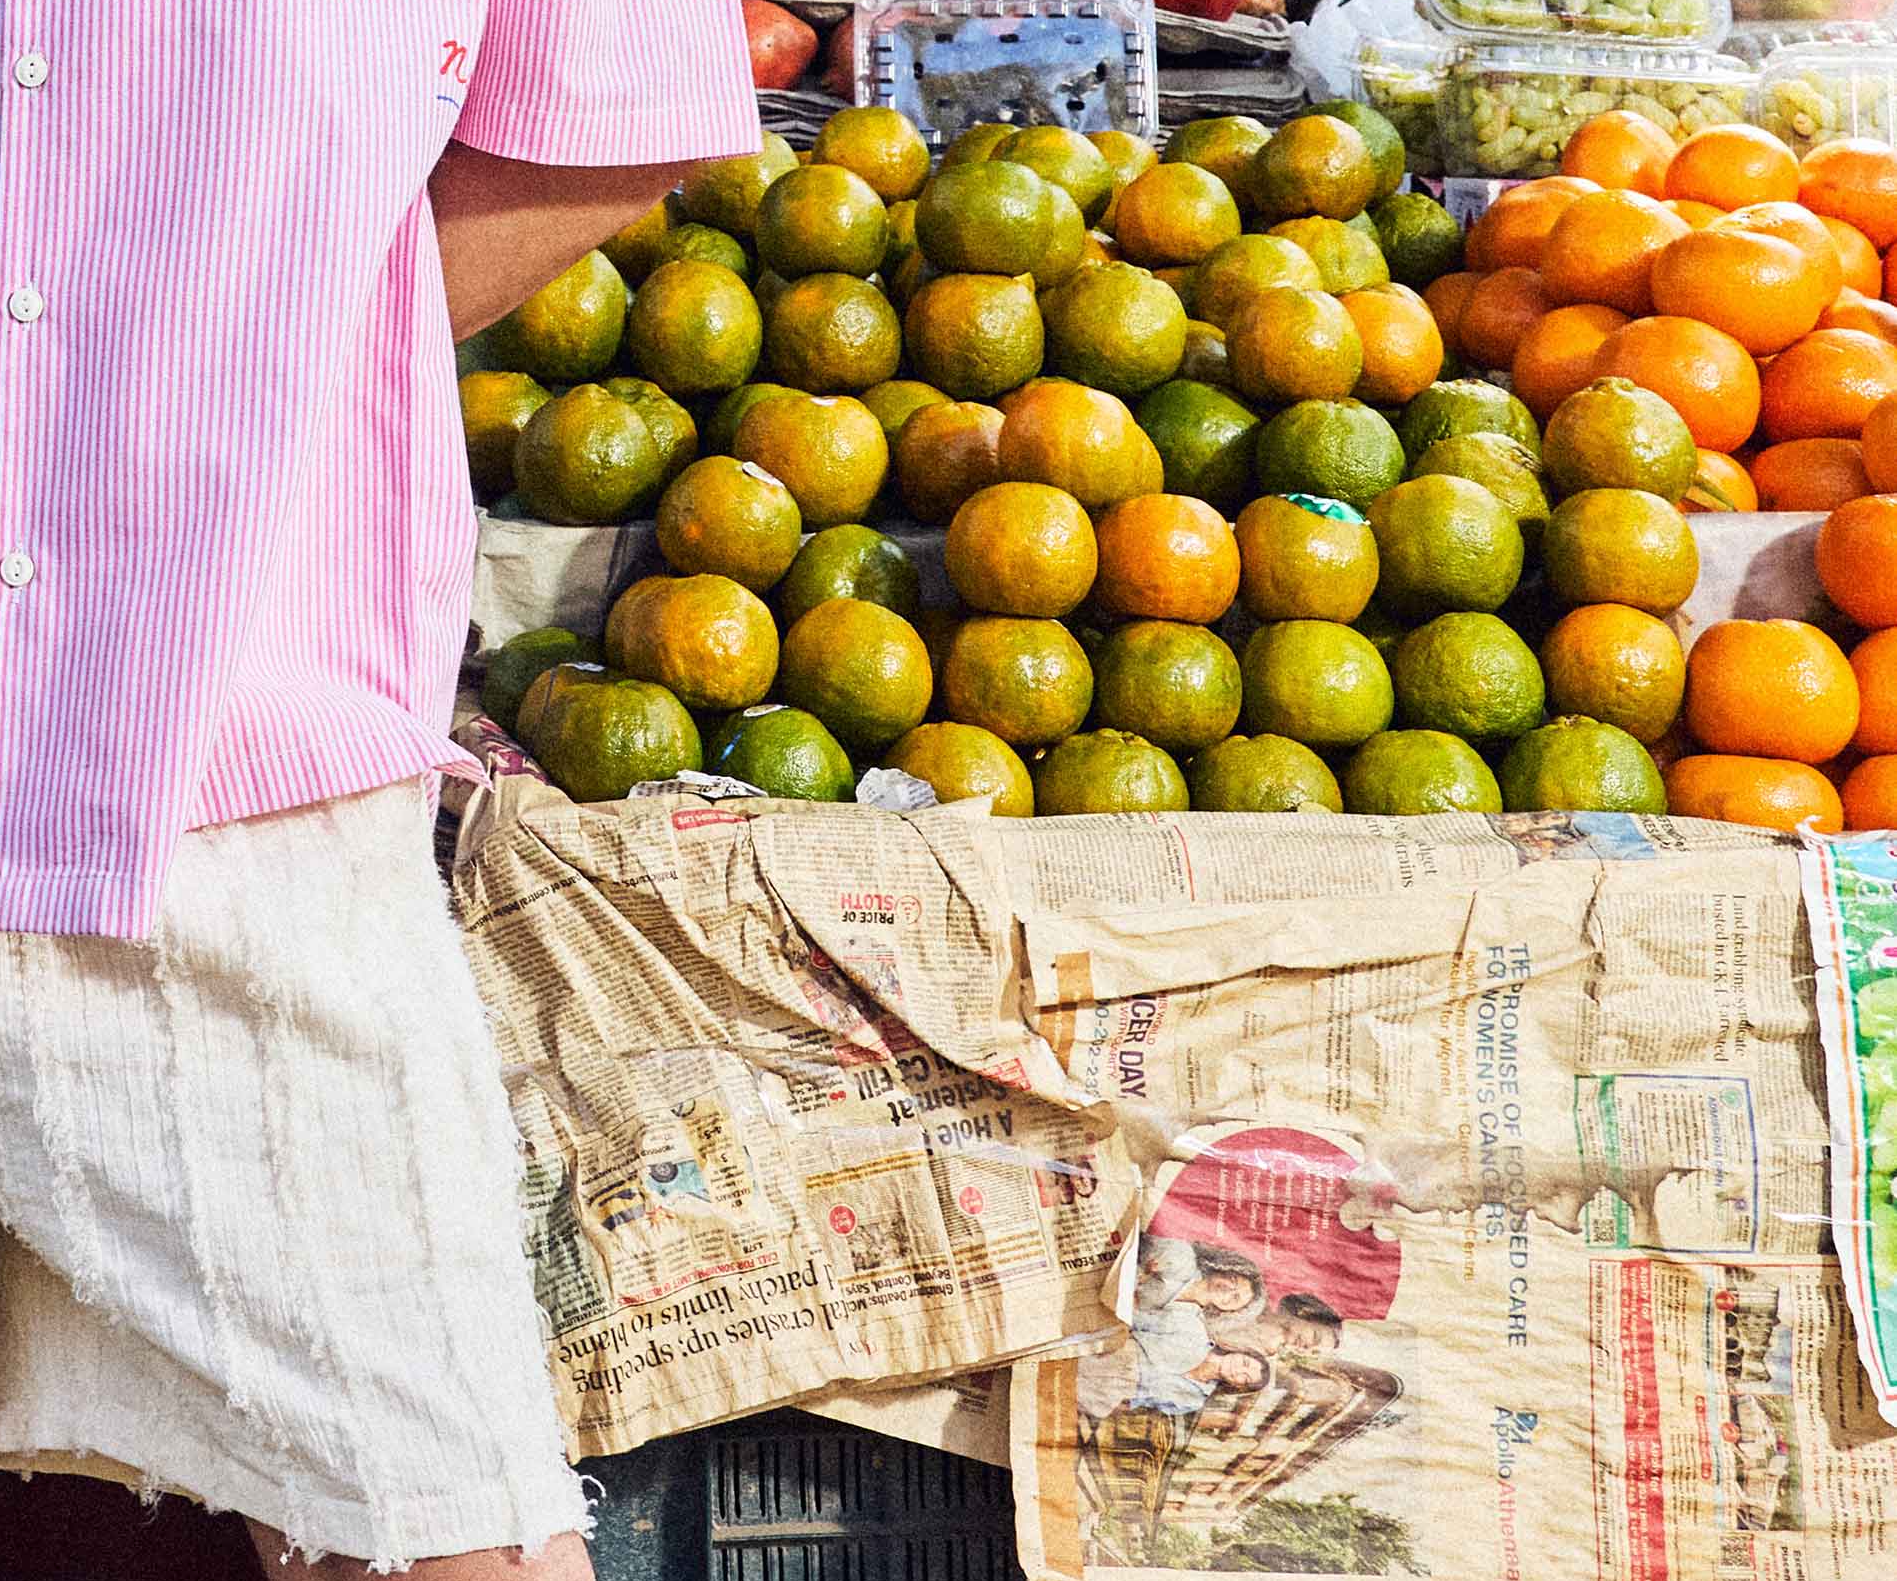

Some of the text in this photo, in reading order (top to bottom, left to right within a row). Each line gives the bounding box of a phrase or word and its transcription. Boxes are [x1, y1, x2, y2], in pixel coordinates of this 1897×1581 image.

[841, 893, 895, 911] SLOTH
[842, 911, 894, 925] PRICE OF
[1712, 894, 1728, 957] busted in
[1475, 988, 1502, 1104] WOMEN'S
[1499, 983, 1523, 1096] PROMISE
[852, 1067, 894, 1102] Fill
[938, 1109, 1013, 1150] A Hole
[1502, 1103, 1522, 1137] OF
[1503, 1145, 1528, 1268] FOCUSED
[738, 1259, 818, 1304] patchy
[845, 1269, 951, 1296] Beyond Says
[1060, 1255, 1096, 1271] RECALL
[630, 1312, 654, 1338] to
[660, 1285, 733, 1331] limits
[724, 1308, 815, 1348] crashes
[1507, 1277, 1528, 1348] CARE
[558, 1320, 627, 1364] blame
[571, 1342, 675, 1397] speeding
